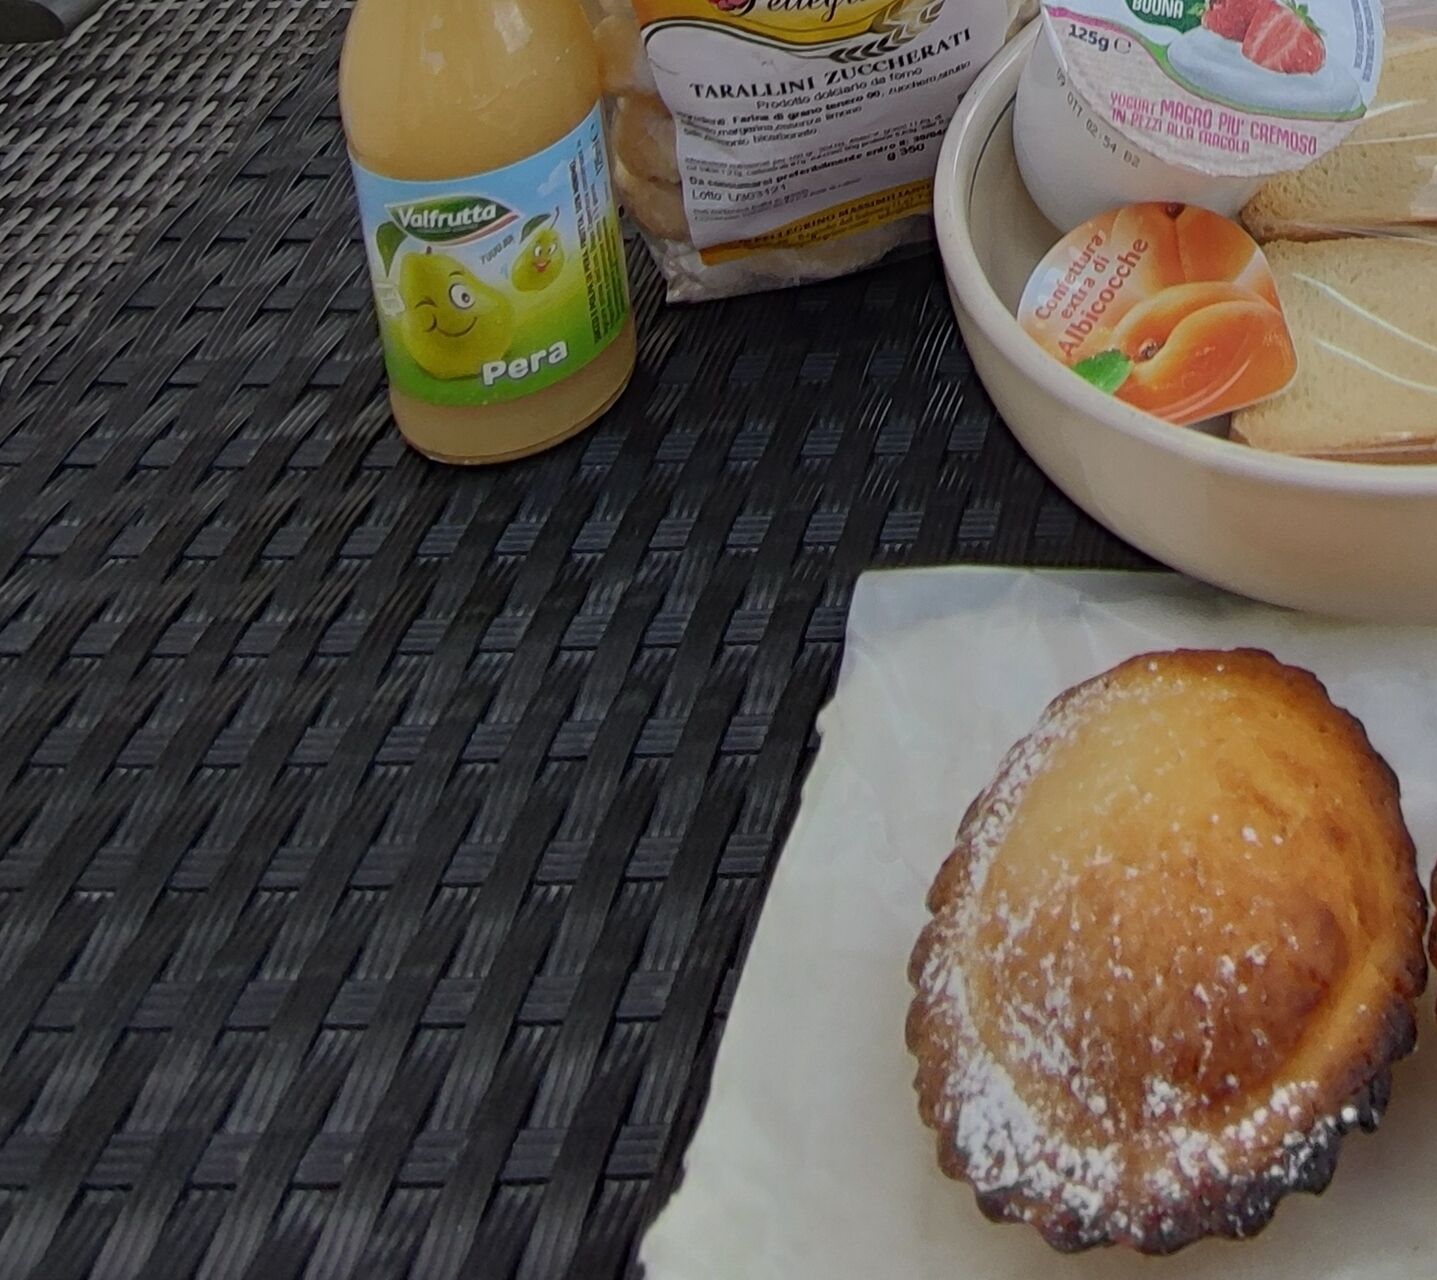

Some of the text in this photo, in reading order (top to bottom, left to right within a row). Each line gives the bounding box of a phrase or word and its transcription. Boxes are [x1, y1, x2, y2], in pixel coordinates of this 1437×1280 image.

[689, 27, 972, 100] TARALLINI ZUCCHERATI
[1068, 23, 1109, 53] 125g
[1110, 92, 1317, 155] YOGURT MAGRO PIU' CREMOSO
[1130, 113, 1163, 132] PEZZI
[1166, 121, 1194, 140] ALLA
[1198, 130, 1250, 154] FRAGOLA
[398, 203, 498, 229] Valfrutta
[1034, 229, 1105, 320] Confettura
[1058, 238, 1149, 357] Albicocche
[1061, 255, 1110, 320] extra di
[480, 339, 570, 387] Pera
